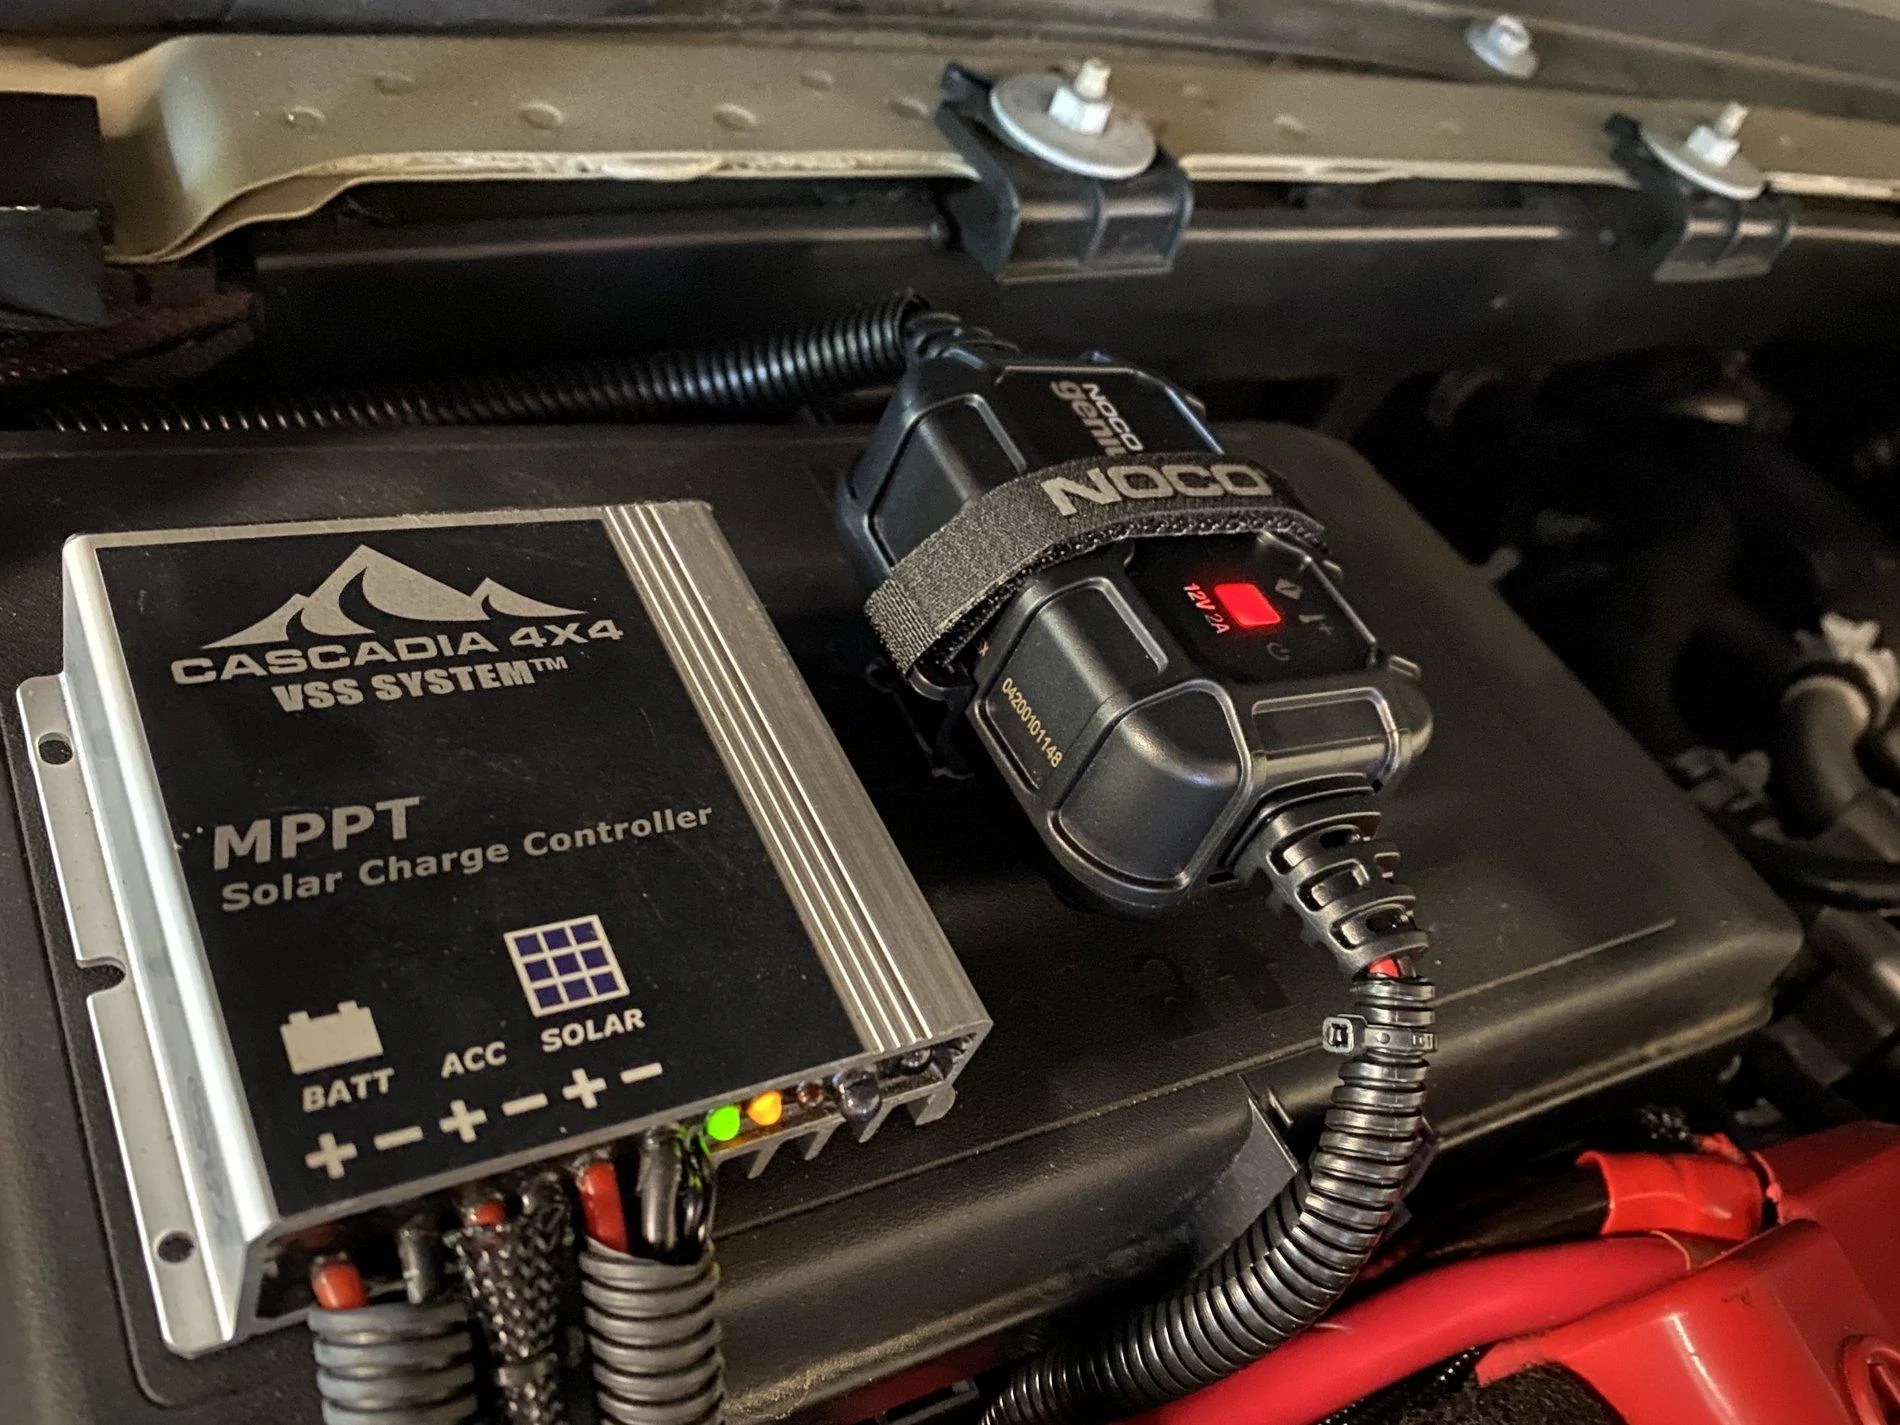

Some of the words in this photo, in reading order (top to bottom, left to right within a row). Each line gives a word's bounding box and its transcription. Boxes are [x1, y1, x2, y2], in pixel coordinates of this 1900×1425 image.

[1081, 383, 1144, 451] NOCO
[1041, 463, 1273, 516] NOCO
[1183, 582, 1216, 612] 12V
[1203, 612, 1231, 634] 2A
[171, 634, 499, 685] CASCADIA
[509, 618, 625, 649] 4X4
[271, 677, 365, 713] VSS
[1001, 677, 1064, 768] 04200101148
[212, 796, 424, 870] MPPT
[221, 868, 344, 912] Solar
[358, 843, 510, 886] Charge
[522, 805, 713, 857] Controller
[540, 1008, 646, 1053] SOLAR
[440, 1041, 508, 1079] ACC
[302, 1067, 395, 1113] BATT
